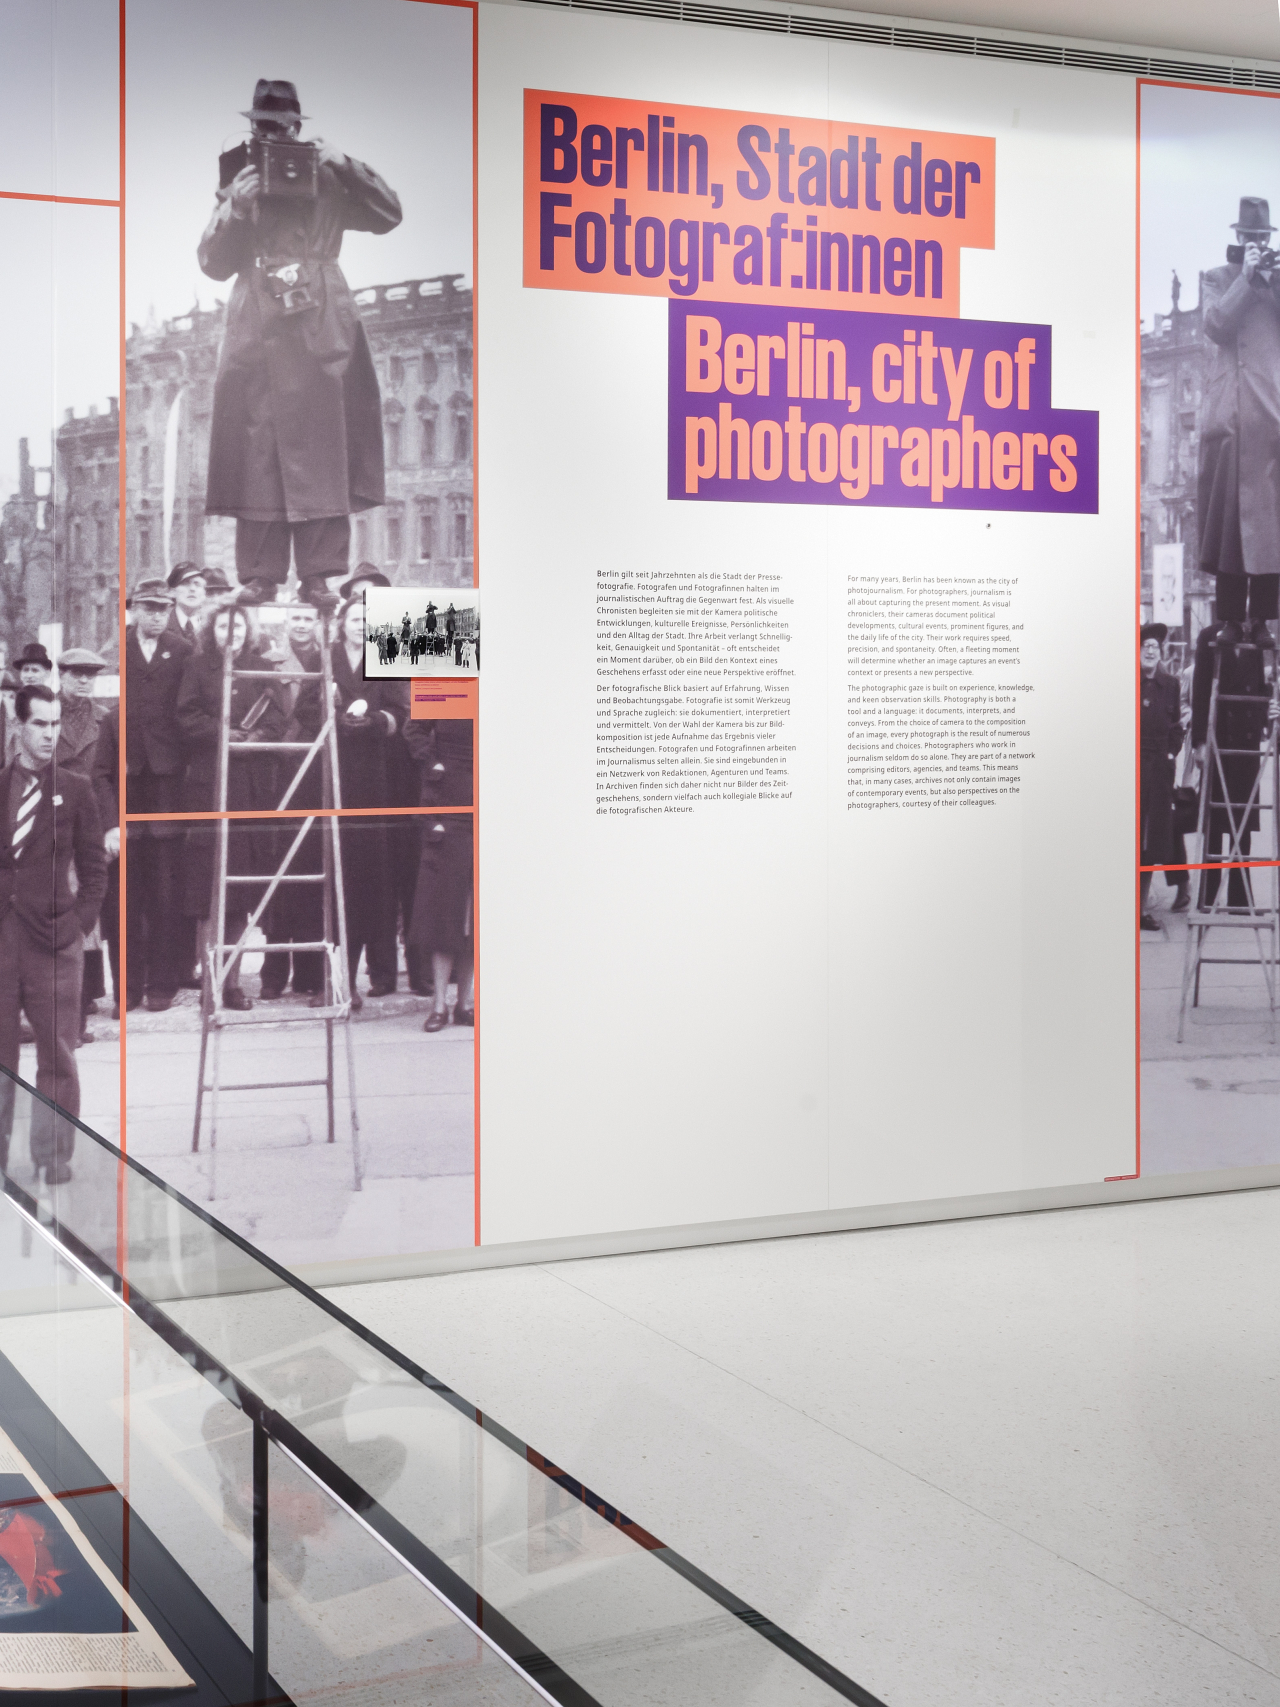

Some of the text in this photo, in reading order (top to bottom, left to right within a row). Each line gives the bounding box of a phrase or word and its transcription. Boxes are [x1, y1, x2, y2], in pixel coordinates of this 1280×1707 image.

[540, 103, 981, 220] Berlin, Stadt der
[540, 191, 943, 299] Fotograf:innen
[685, 315, 1036, 421] Berlin, city of
[685, 403, 1077, 502] photographers
[597, 569, 619, 579] Berlin
[621, 570, 633, 580] gilt
[636, 570, 649, 579] seit
[651, 570, 695, 581] Jahrzehnten
[698, 571, 708, 580] als
[710, 571, 721, 580] die
[723, 571, 741, 581] Stadt
[744, 572, 755, 581] der
[637, 582, 677, 593] Fotografen
[679, 583, 693, 592] und
[694, 583, 745, 594] Fotografinnen
[746, 584, 769, 593] halten
[596, 594, 655, 605] journalistischen
[656, 595, 684, 605] Auftrag
[686, 595, 697, 604] die
[698, 595, 737, 606] Gegenwart
[756, 596, 767, 605] Als
[768, 596, 794, 605] visuelle
[597, 606, 778, 618] Chronisten begleiten sie mit der Kamera politische
[655, 619, 690, 628] kulturelle
[731, 620, 789, 629] Persönlichkeiten
[597, 630, 611, 639] und
[613, 631, 626, 640] den
[629, 631, 649, 641] Alltag
[652, 631, 663, 640] der
[688, 631, 702, 640] Ihre
[705, 631, 726, 641] Arbeit
[728, 632, 757, 642] verlangt
[615, 643, 660, 654] Genauigkeit
[662, 643, 676, 652] und
[677, 643, 720, 654] Spontanität
[727, 643, 737, 652] oft
[739, 643, 780, 653] entscheidet
[597, 655, 608, 664] ein
[610, 655, 641, 664] Moment
[687, 655, 697, 664] ein
[700, 655, 712, 664] Bild
[715, 655, 727, 664] den
[730, 655, 757, 664] Kontext
[760, 655, 777, 664] eines
[597, 667, 640, 676] Geschehens
[642, 667, 667, 676] erfasst
[669, 667, 685, 676] oder
[687, 667, 702, 676] eine
[723, 667, 764, 678] Perspektive
